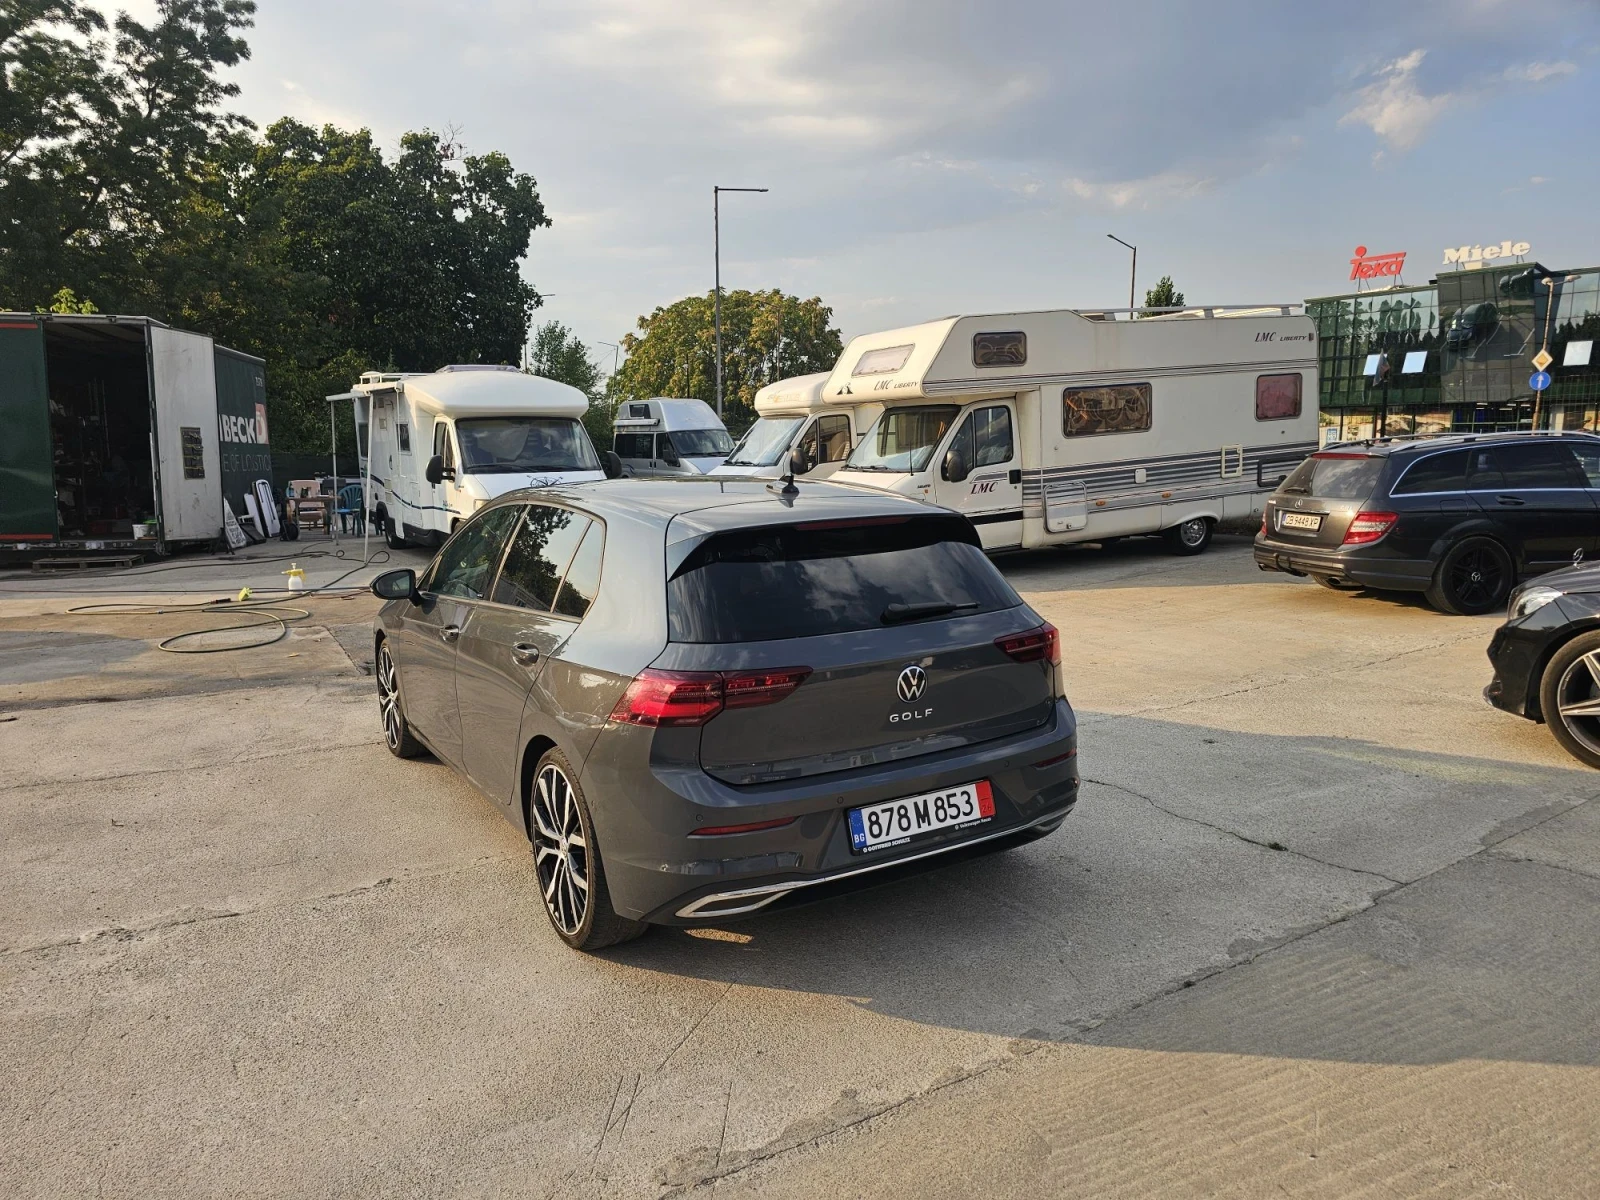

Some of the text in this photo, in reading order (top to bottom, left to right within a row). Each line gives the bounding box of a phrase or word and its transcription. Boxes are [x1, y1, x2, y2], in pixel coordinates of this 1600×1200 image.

[1442, 241, 1531, 265] Miele
[1350, 245, 1407, 280] Teka
[1255, 332, 1276, 342] LMC
[874, 379, 893, 391] LMC
[971, 481, 998, 494] LMC
[890, 708, 933, 723] GOLF
[854, 833, 865, 843] BG
